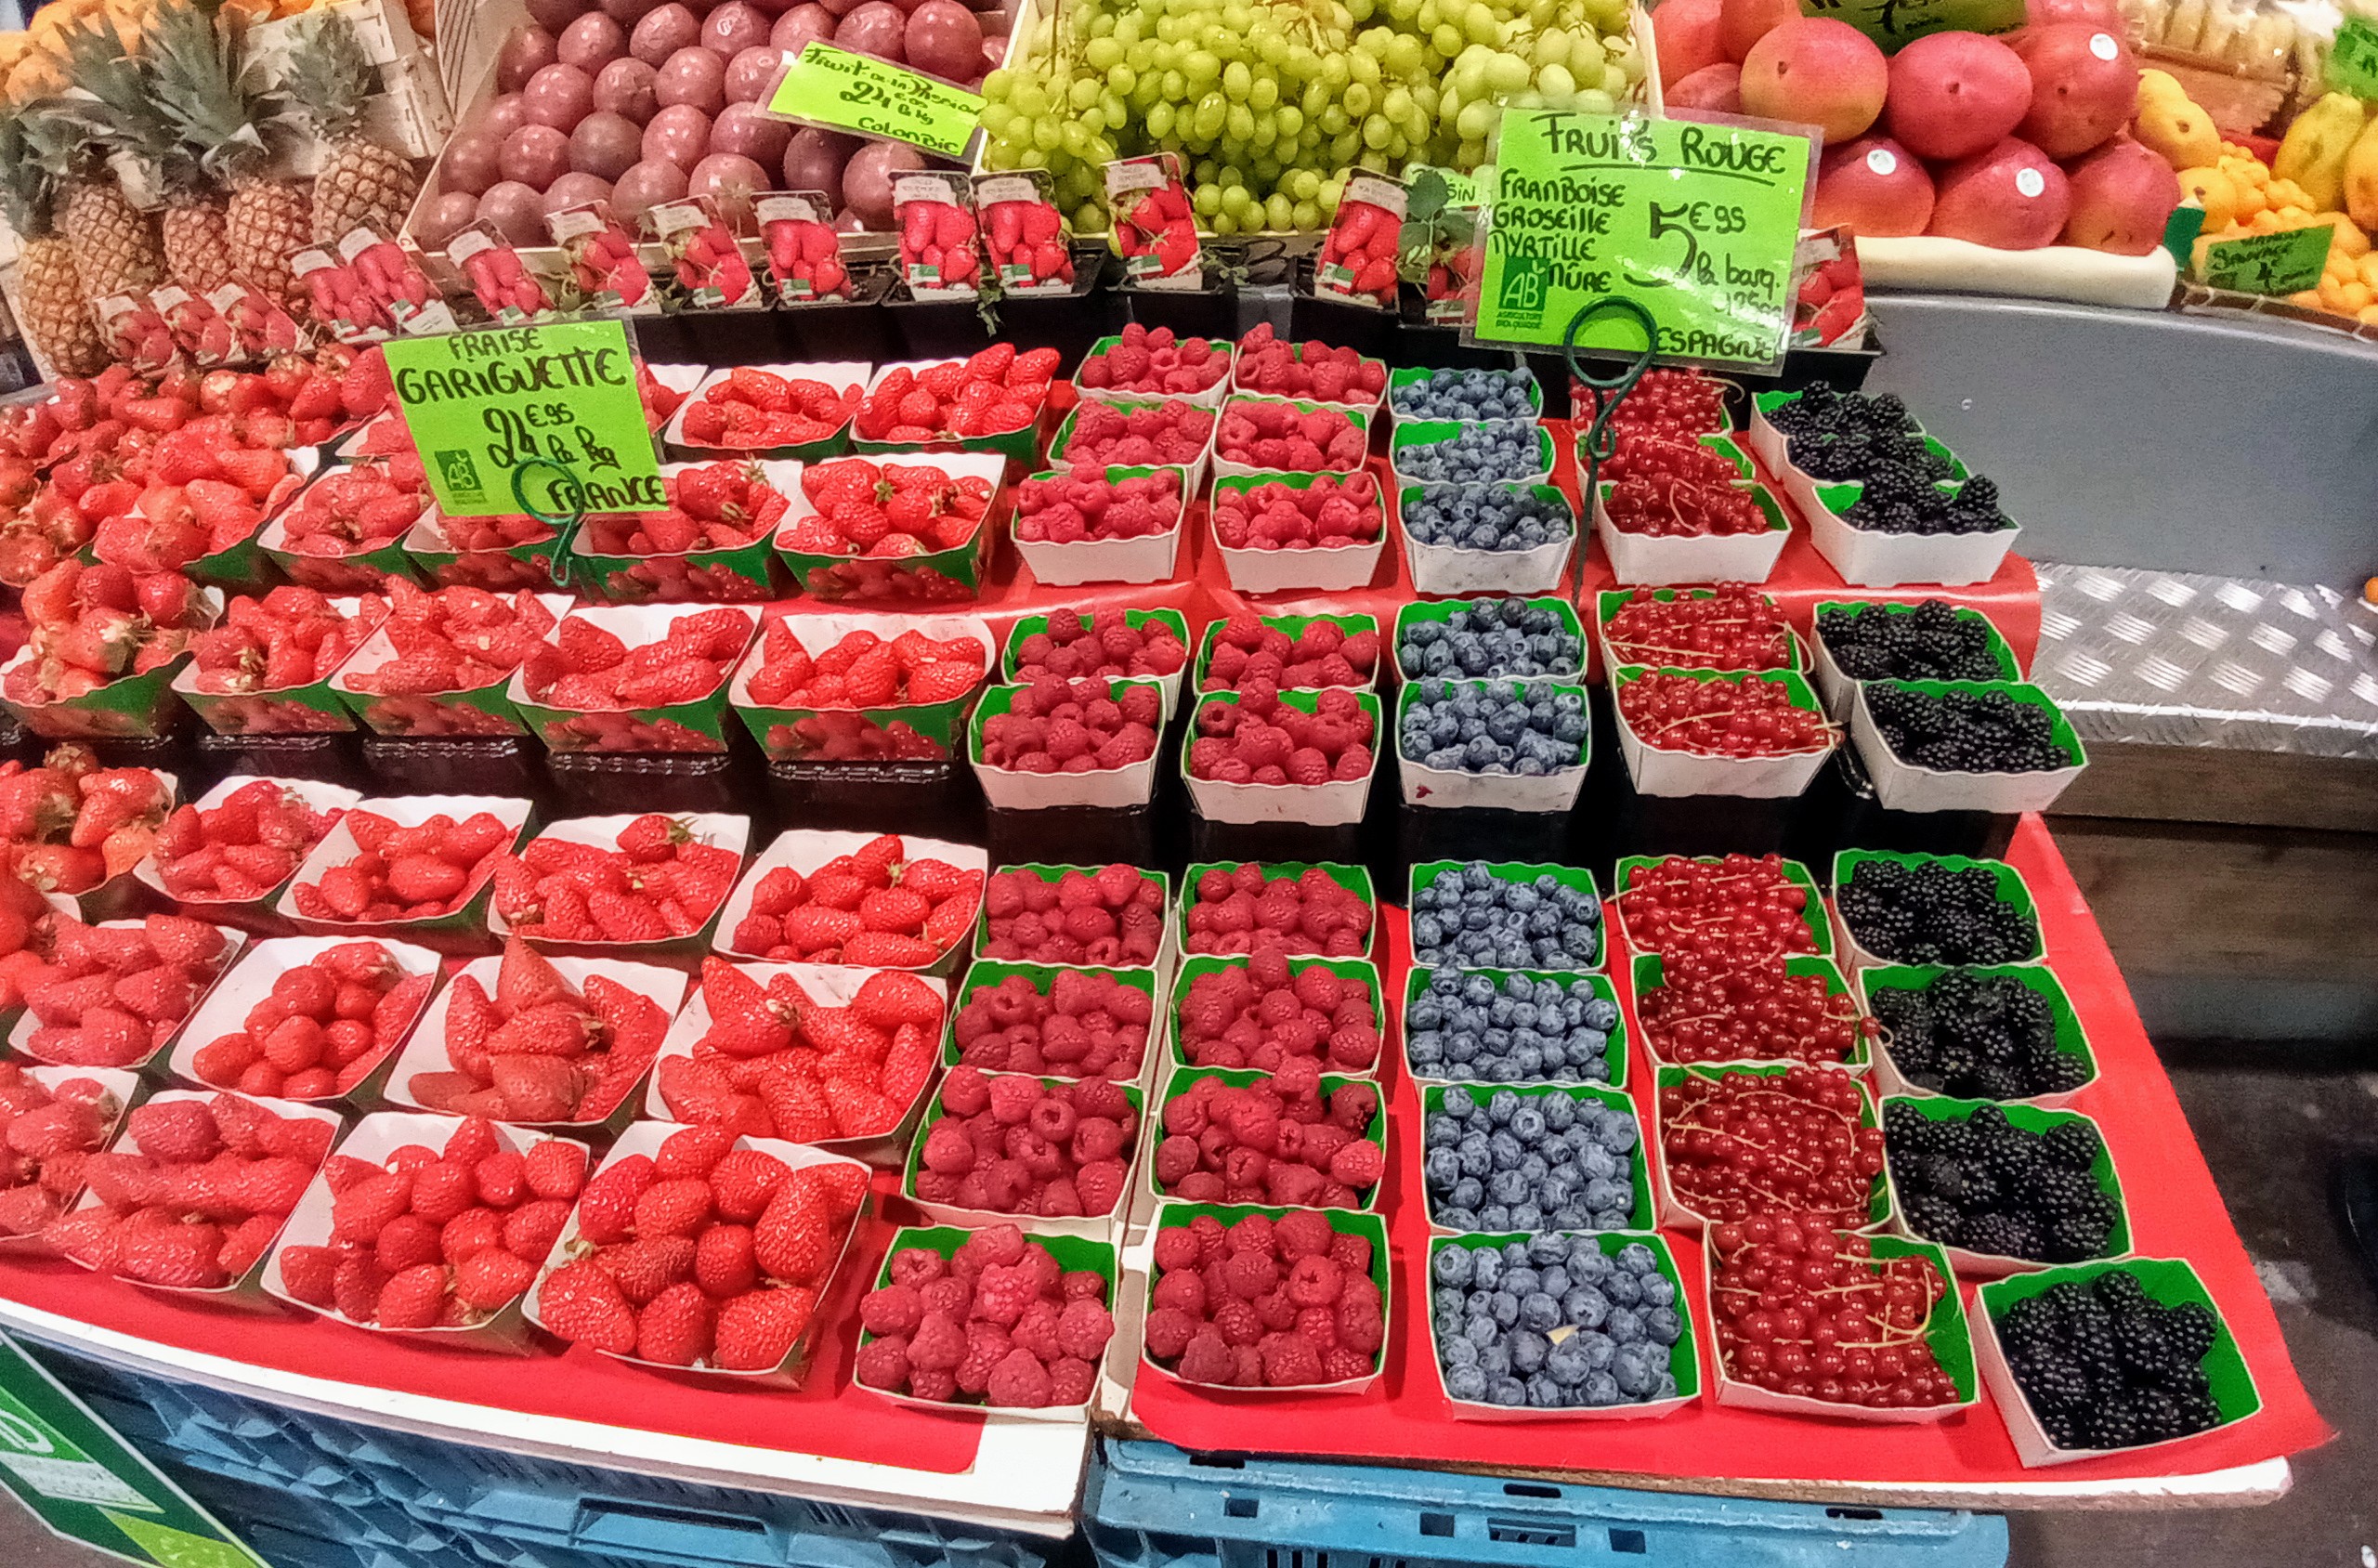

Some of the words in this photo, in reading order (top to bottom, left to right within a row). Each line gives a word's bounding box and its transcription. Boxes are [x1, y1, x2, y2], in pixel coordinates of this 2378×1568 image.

[1530, 111, 1658, 163] FRUIS
[1680, 125, 1786, 175] ROUGE
[1502, 271, 1539, 308] AB
[448, 327, 543, 362] FRAISE
[1656, 326, 1772, 361] ESPAGNE
[396, 346, 627, 405] GARIGUETTE
[545, 475, 668, 512] FRANCE
